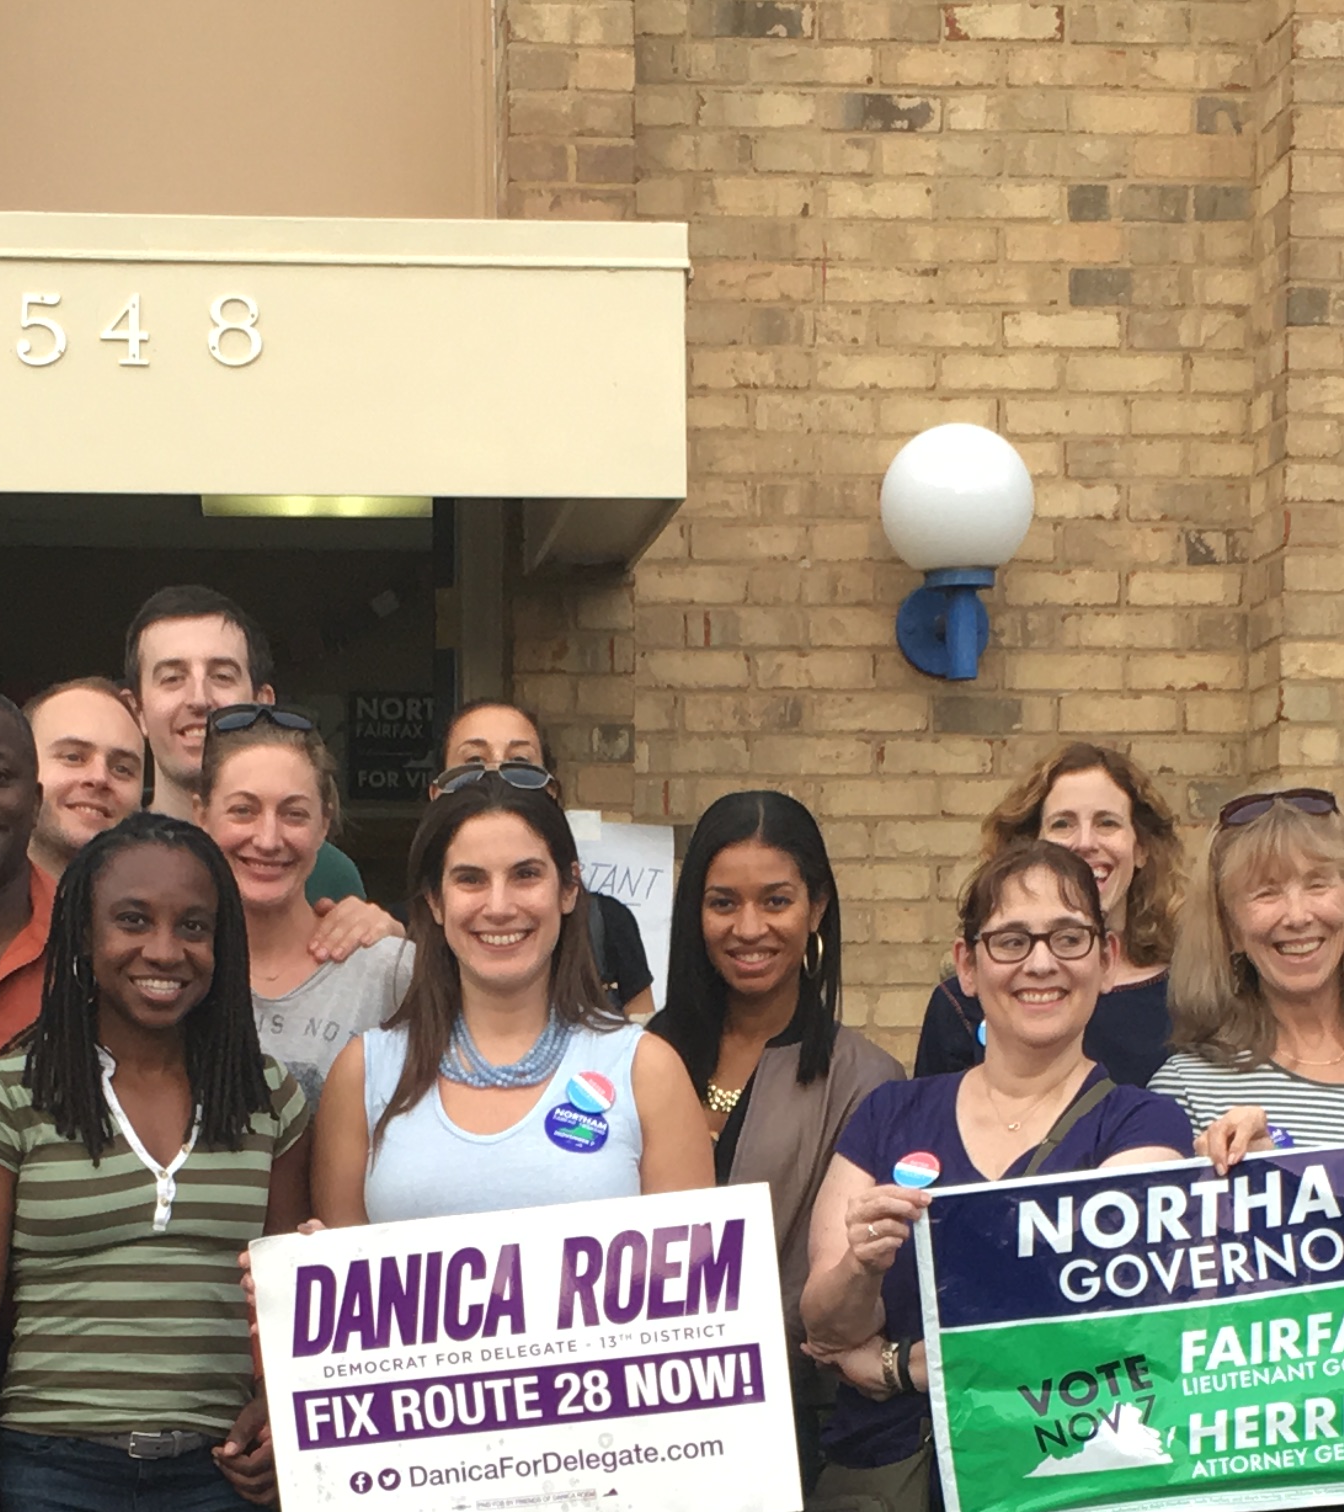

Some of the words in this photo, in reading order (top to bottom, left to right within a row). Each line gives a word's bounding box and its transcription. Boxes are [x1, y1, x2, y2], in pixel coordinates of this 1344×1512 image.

[356, 722, 423, 738] FAIRFAX
[358, 770, 399, 788] FOR
[553, 1107, 608, 1131] NORTHAM
[292, 1242, 527, 1359] DANICA
[557, 1217, 746, 1331] ROEM
[323, 1354, 428, 1379] DEMOCRAT
[436, 1349, 473, 1366] FOR
[481, 1339, 578, 1363] DELEGATE
[640, 1323, 727, 1345] DISTRICT
[304, 1395, 380, 1442] FIX
[390, 1374, 543, 1434] ROUTE
[554, 1368, 613, 1416] 28
[624, 1351, 754, 1409] NOW!
[1017, 1353, 1154, 1418] VOTE
[1181, 1360, 1318, 1397] LIEUTENANT
[1033, 1402, 1122, 1454] NOV
[1135, 1394, 1157, 1426] 7
[409, 1436, 725, 1489] DanicaForDelegate.com
[1191, 1447, 1309, 1480] ATTORNEY
